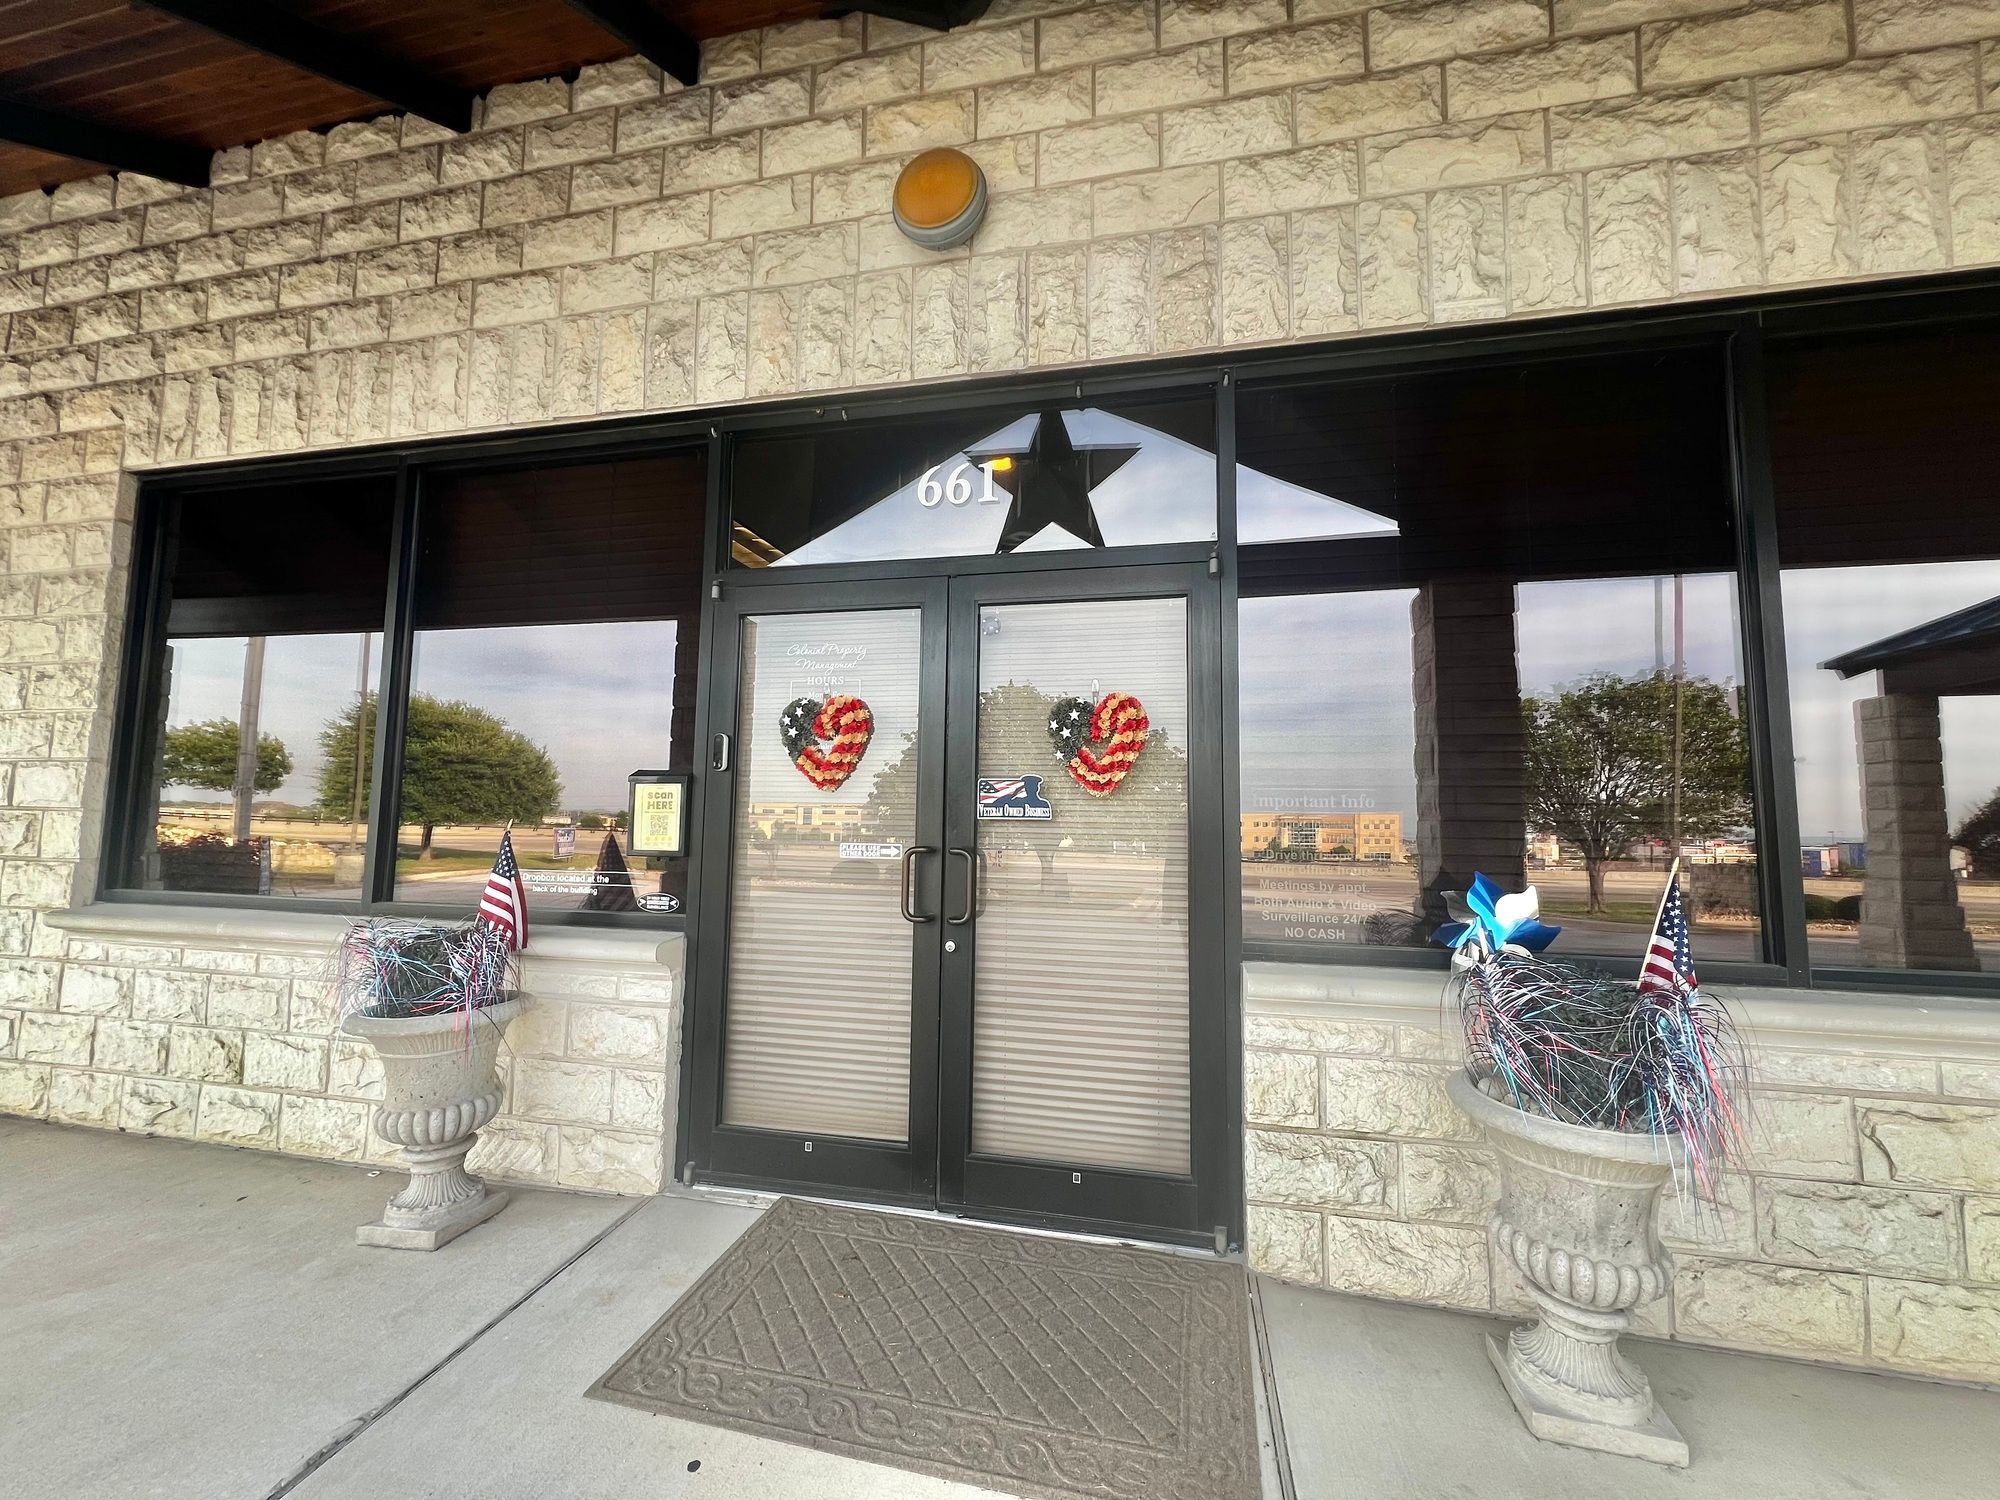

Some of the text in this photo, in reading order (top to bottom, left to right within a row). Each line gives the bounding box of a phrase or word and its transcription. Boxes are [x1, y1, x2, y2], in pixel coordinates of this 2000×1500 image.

[917, 462, 999, 507] 661
[786, 643, 867, 660] Colonial Property
[795, 658, 858, 675] Management
[807, 676, 845, 685] HOURS
[647, 800, 673, 810] HERE
[1341, 794, 1376, 809] Info
[1265, 849, 1297, 860] Drive
[522, 873, 555, 882] Dropbox
[557, 874, 585, 883] located
[532, 885, 548, 893] back
[549, 885, 557, 893] of
[570, 887, 598, 896] building
[1259, 879, 1370, 895] Meetings by appt.
[1255, 897, 1377, 911] Both Audio & Video
[1261, 910, 1369, 925] Surveillance 24/7
[1285, 926, 1346, 940] NO CASH
